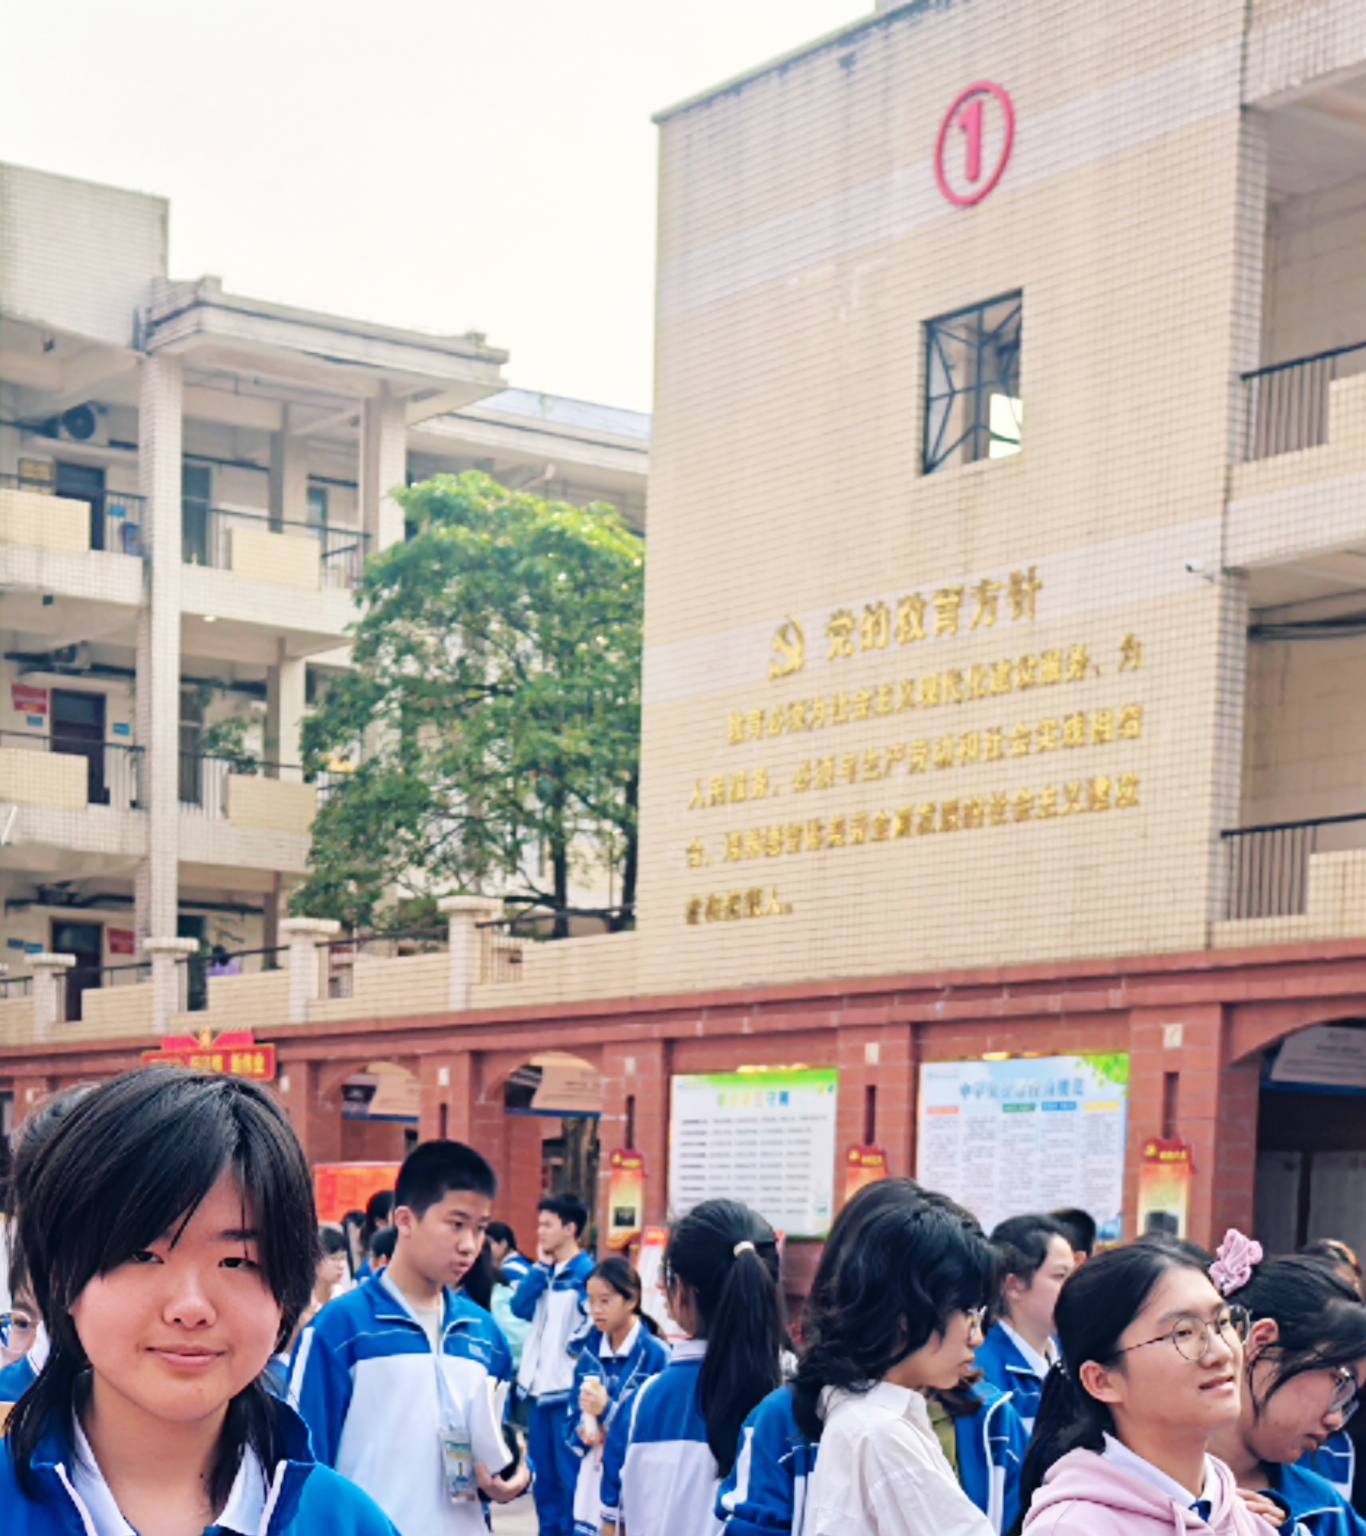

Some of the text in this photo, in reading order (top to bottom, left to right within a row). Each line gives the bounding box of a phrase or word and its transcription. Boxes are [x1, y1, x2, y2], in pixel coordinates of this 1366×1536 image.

[825, 565, 1044, 661] 党的教育方针
